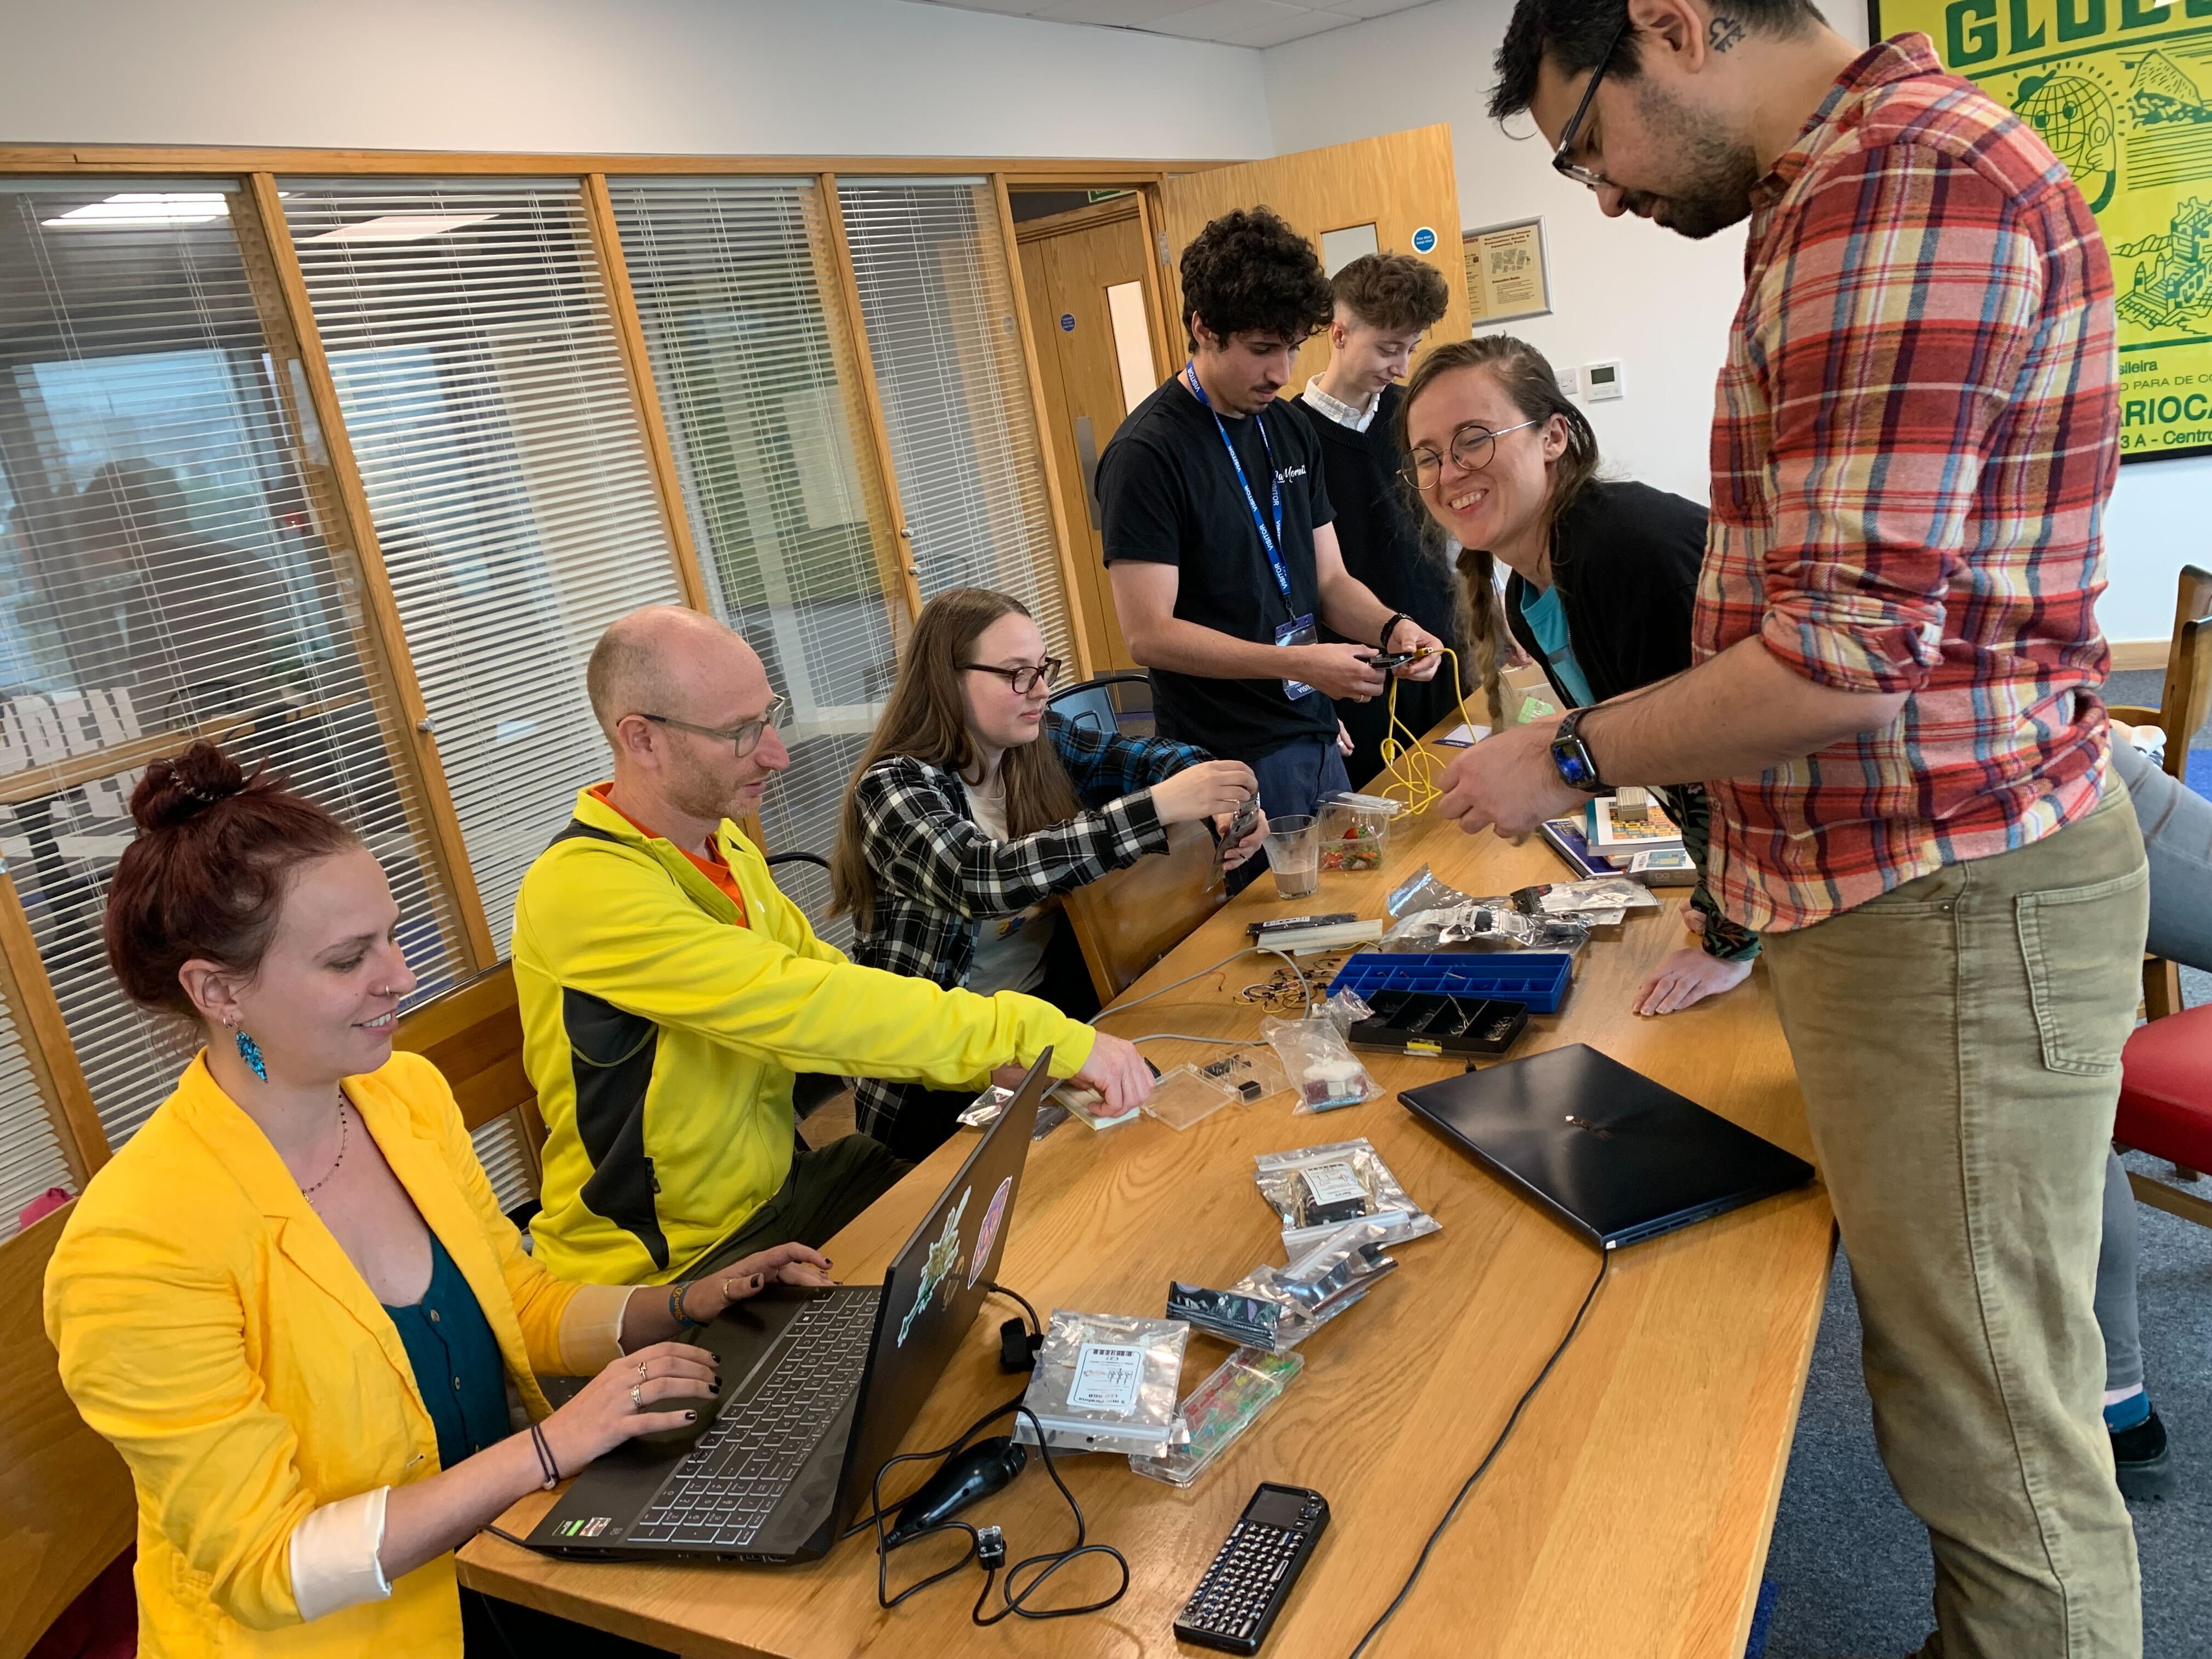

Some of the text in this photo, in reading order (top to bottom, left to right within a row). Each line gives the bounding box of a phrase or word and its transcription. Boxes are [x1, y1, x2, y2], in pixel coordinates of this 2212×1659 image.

[1187, 366, 1201, 393] VISITOR
[2133, 378, 2170, 390] PARA
[2174, 375, 2194, 385] DE
[1228, 445, 1242, 473] VISITOR
[1244, 484, 1258, 512] VISITOR
[1259, 523, 1273, 551] VISITOR
[1274, 562, 1288, 590] VISITOR
